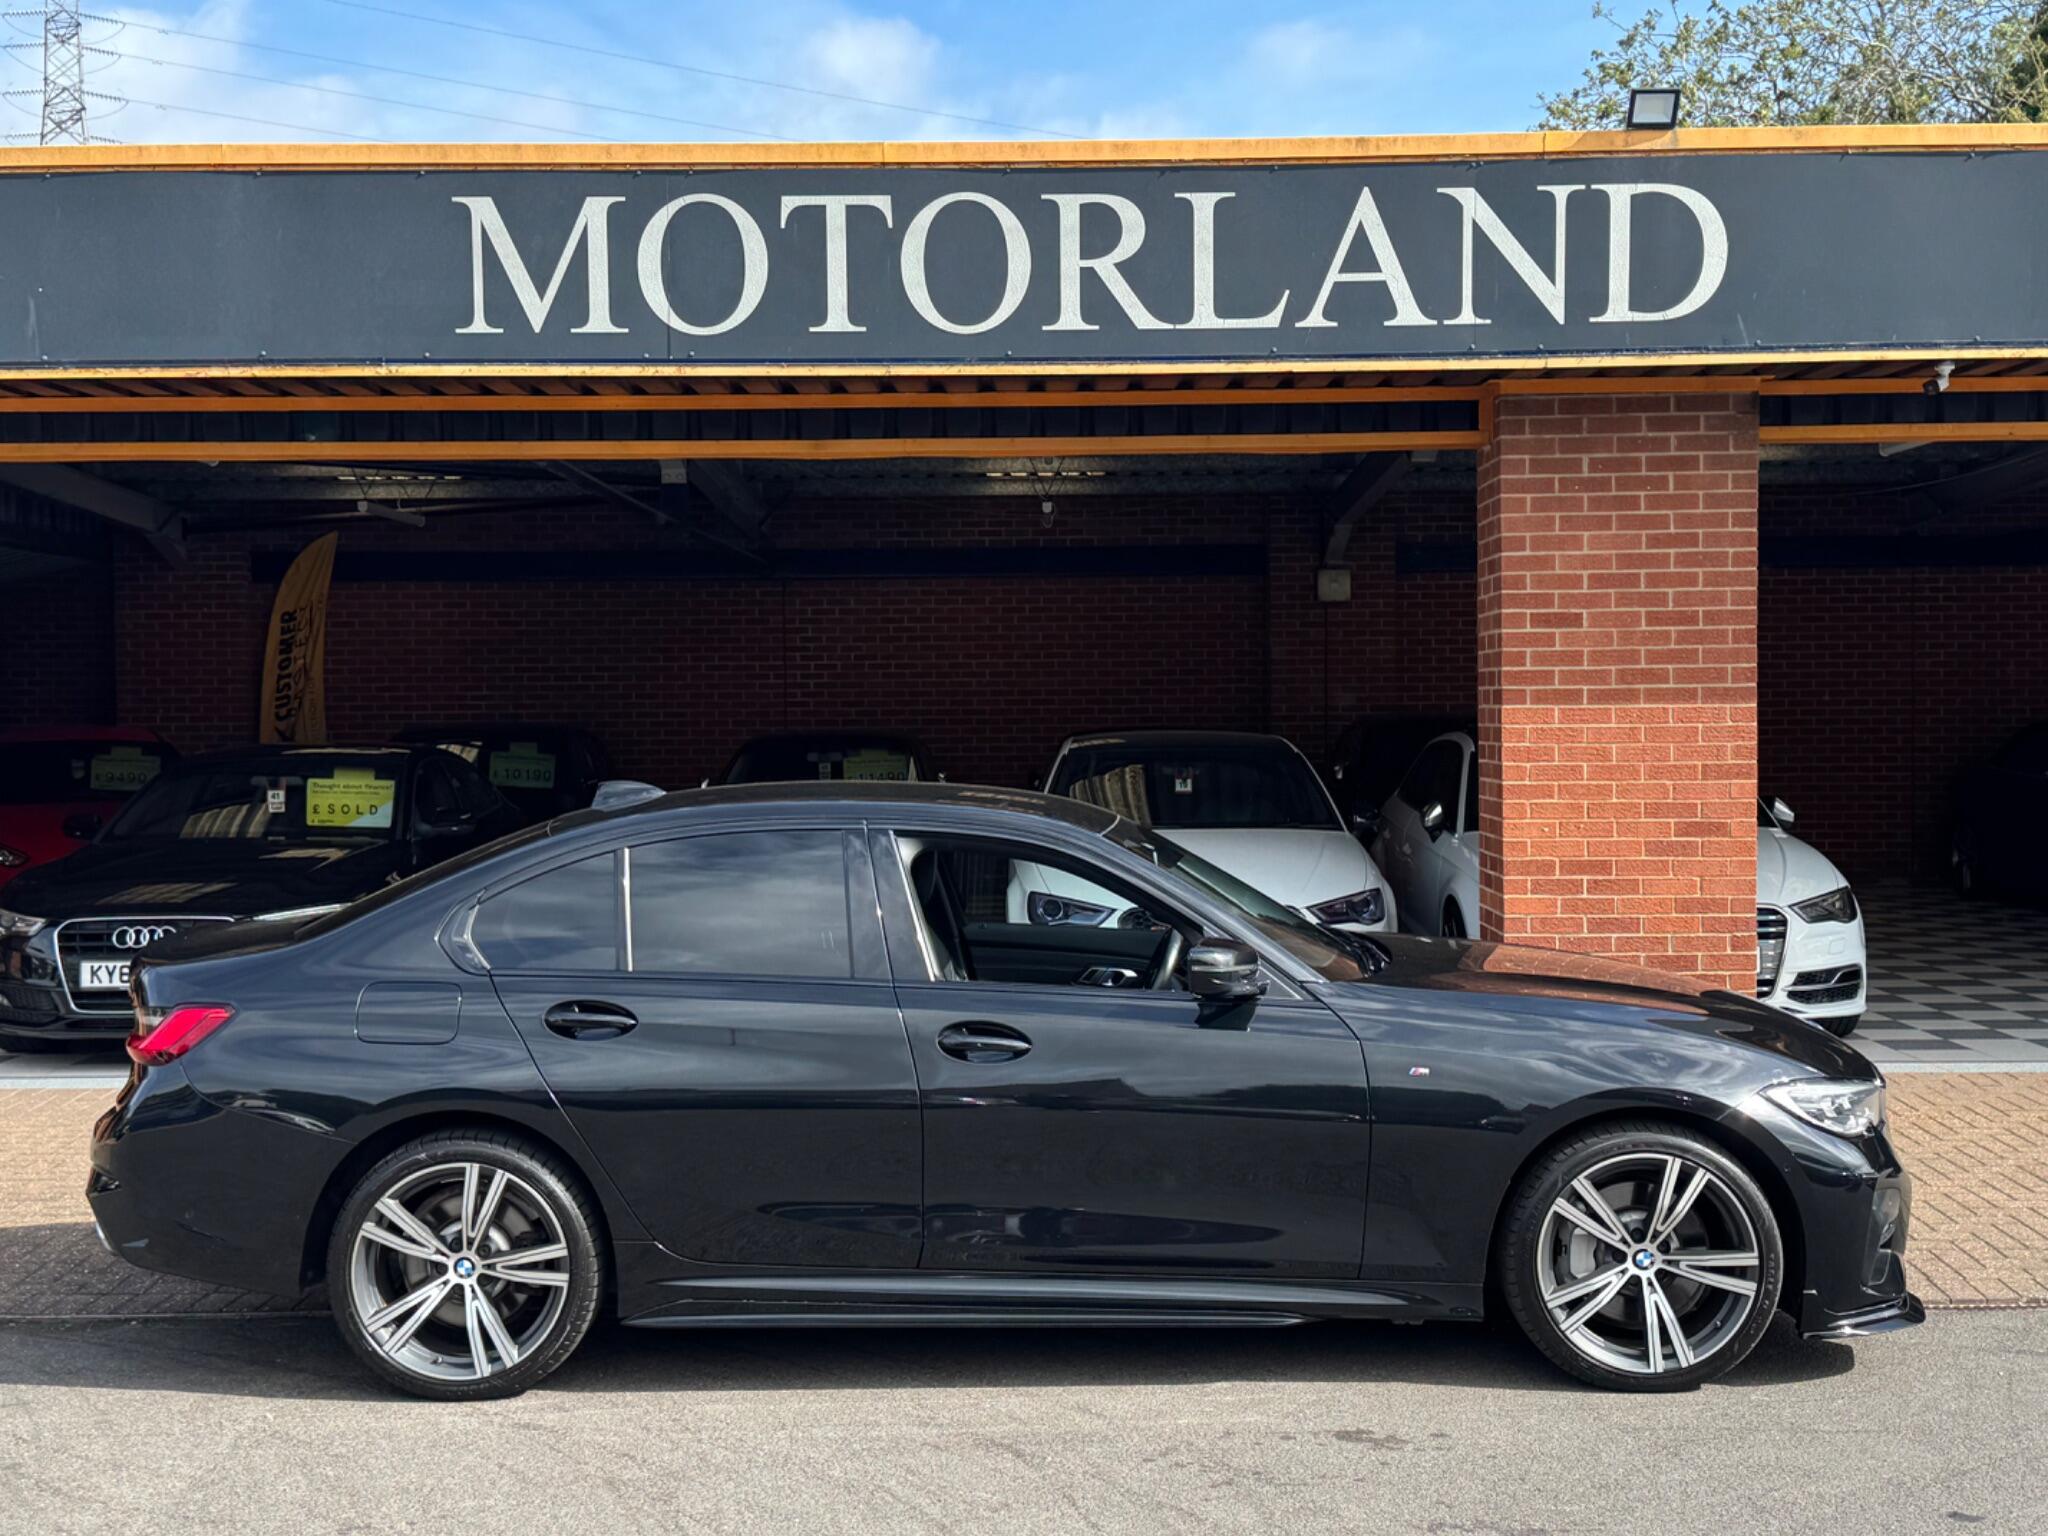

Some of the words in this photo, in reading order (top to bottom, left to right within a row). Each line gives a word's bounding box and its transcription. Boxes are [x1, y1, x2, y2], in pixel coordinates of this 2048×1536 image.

[451, 183, 1729, 336] MOTORLAND
[274, 609, 298, 722] CUSTOMER
[327, 803, 379, 815] SOLD
